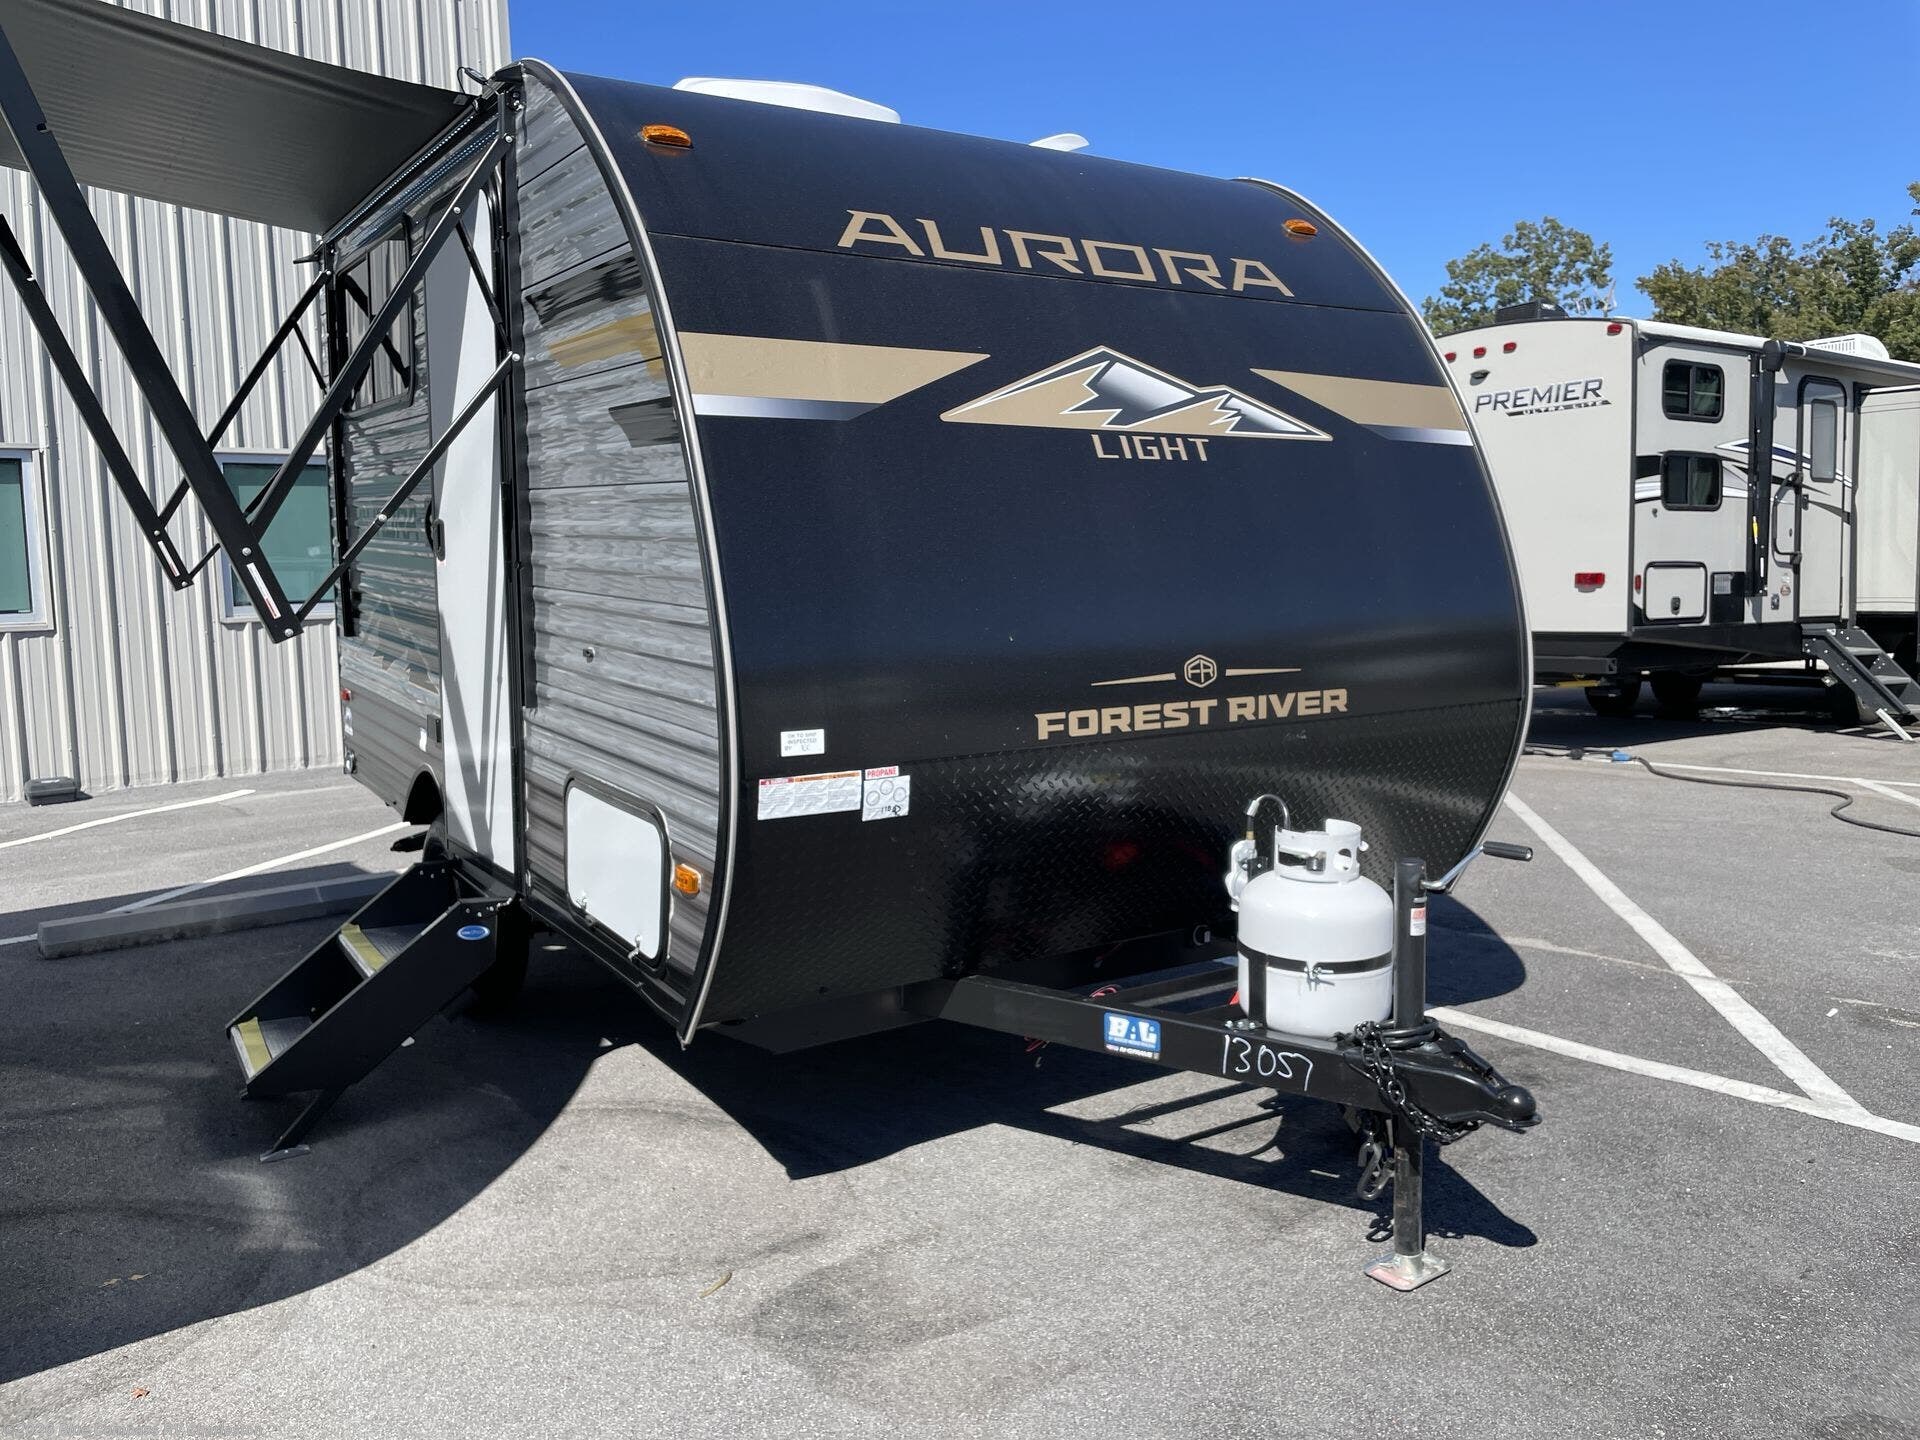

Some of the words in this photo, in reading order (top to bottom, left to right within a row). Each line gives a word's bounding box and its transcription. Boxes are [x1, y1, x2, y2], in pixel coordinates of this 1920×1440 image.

[837, 209, 1295, 297] AURORA
[1474, 378, 1604, 413] PREMIER
[1091, 434, 1209, 462] LIGHT
[1034, 699, 1218, 740] FOREST
[1226, 688, 1348, 722] RIVER
[867, 767, 897, 778] PROPANE
[1222, 1034, 1314, 1091] 13057
